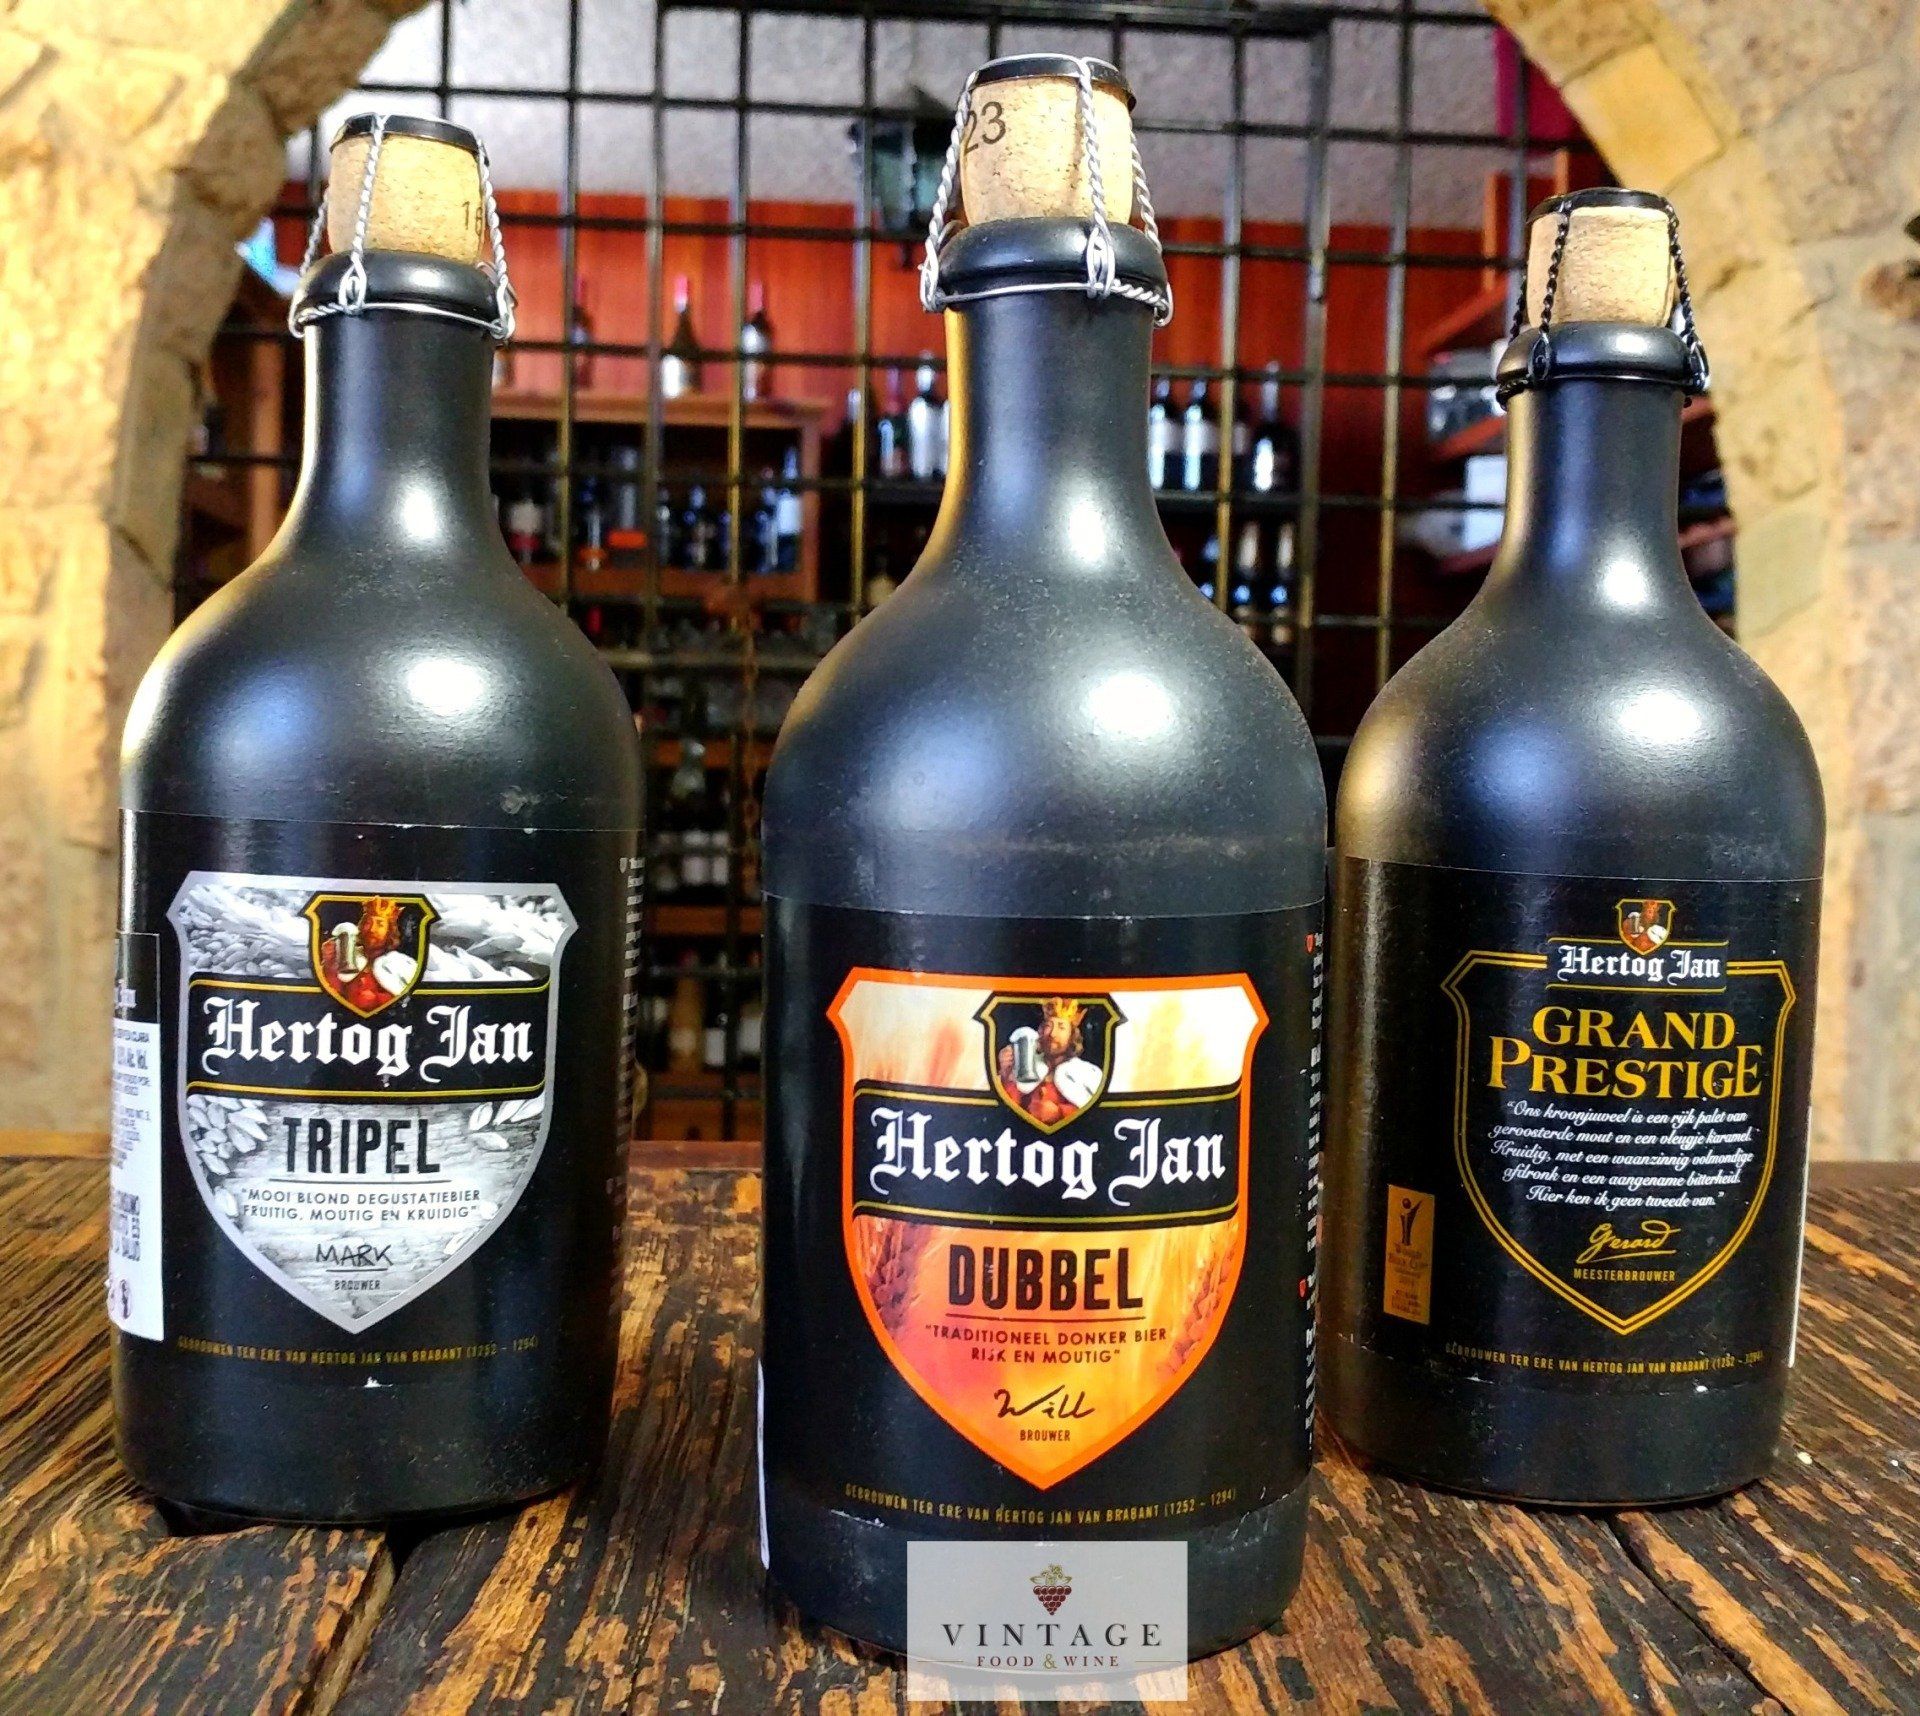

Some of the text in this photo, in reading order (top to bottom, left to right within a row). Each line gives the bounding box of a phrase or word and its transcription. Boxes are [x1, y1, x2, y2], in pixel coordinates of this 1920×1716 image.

[1556, 945, 1721, 986] Hertog Jan
[203, 997, 534, 1083] Hertog Jan
[1532, 1006, 1736, 1050] GRAND
[1489, 1036, 1762, 1098] PRESTIGE
[1544, 1103, 1631, 1127] kroonjuweel
[1632, 1110, 1644, 1123] is
[1647, 1113, 1669, 1124] een
[1671, 1110, 1695, 1130] rijk
[1694, 1108, 1726, 1129] palet
[1726, 1111, 1748, 1122] van
[283, 1117, 440, 1174] TRIPEL
[1488, 1124, 1575, 1141] geroosterde
[1576, 1130, 1613, 1143] mout
[1615, 1134, 1631, 1143] en
[1634, 1133, 1657, 1144] een
[869, 1107, 1226, 1206] Hertog Jan
[1491, 1140, 1754, 1171] Kruidig, met een waanzinnig volmondige
[1502, 1166, 1740, 1190] afdronk en een aangename bitterheid.
[298, 1192, 350, 1205] BLOND
[357, 1190, 480, 1205] DEGUSTATIEBIER
[1526, 1185, 1564, 1201] Hier
[1566, 1190, 1591, 1204] ken
[1594, 1191, 1608, 1206] ik
[1606, 1196, 1642, 1211] geen
[1646, 1194, 1690, 1207] tweede
[243, 1205, 303, 1220] FRUITIG,
[310, 1209, 373, 1221] MOUTIG
[381, 1209, 400, 1221] EN
[316, 1243, 394, 1267] MARK
[334, 1279, 381, 1290] BROUWER
[948, 1244, 1143, 1311] DUBBEL
[1574, 1268, 1676, 1281] MEESTERBROUWER
[1057, 1331, 1126, 1346] DONKER
[1135, 1328, 1167, 1342] BIER
[286, 1350, 306, 1363] VAN
[311, 1350, 356, 1364] HERTOG
[360, 1351, 382, 1364] JAN
[386, 1350, 407, 1363] VAN
[412, 1347, 462, 1363] BRABANT
[972, 1347, 1005, 1362] RIJK
[1014, 1350, 1035, 1363] EN
[1509, 1353, 1529, 1366] TER
[1534, 1357, 1553, 1369] ERE
[1559, 1360, 1578, 1371] VAN
[1583, 1360, 1623, 1373] HERTOG
[1627, 1363, 1644, 1373] JAN
[1649, 1362, 1666, 1373] VAN
[1670, 1358, 1709, 1373] BRABANT
[994, 1385, 1095, 1418] Will
[1020, 1430, 1070, 1441] BROUWER
[845, 1483, 908, 1511] GEBROUWEN
[913, 1500, 933, 1514] TER
[939, 1504, 961, 1519] ERE
[967, 1506, 989, 1521] VAN
[995, 1507, 1044, 1524] HERTOG
[1050, 1511, 1072, 1524] JAN
[1078, 1510, 1100, 1524] VAN
[1106, 1505, 1159, 1522] BRABANT
